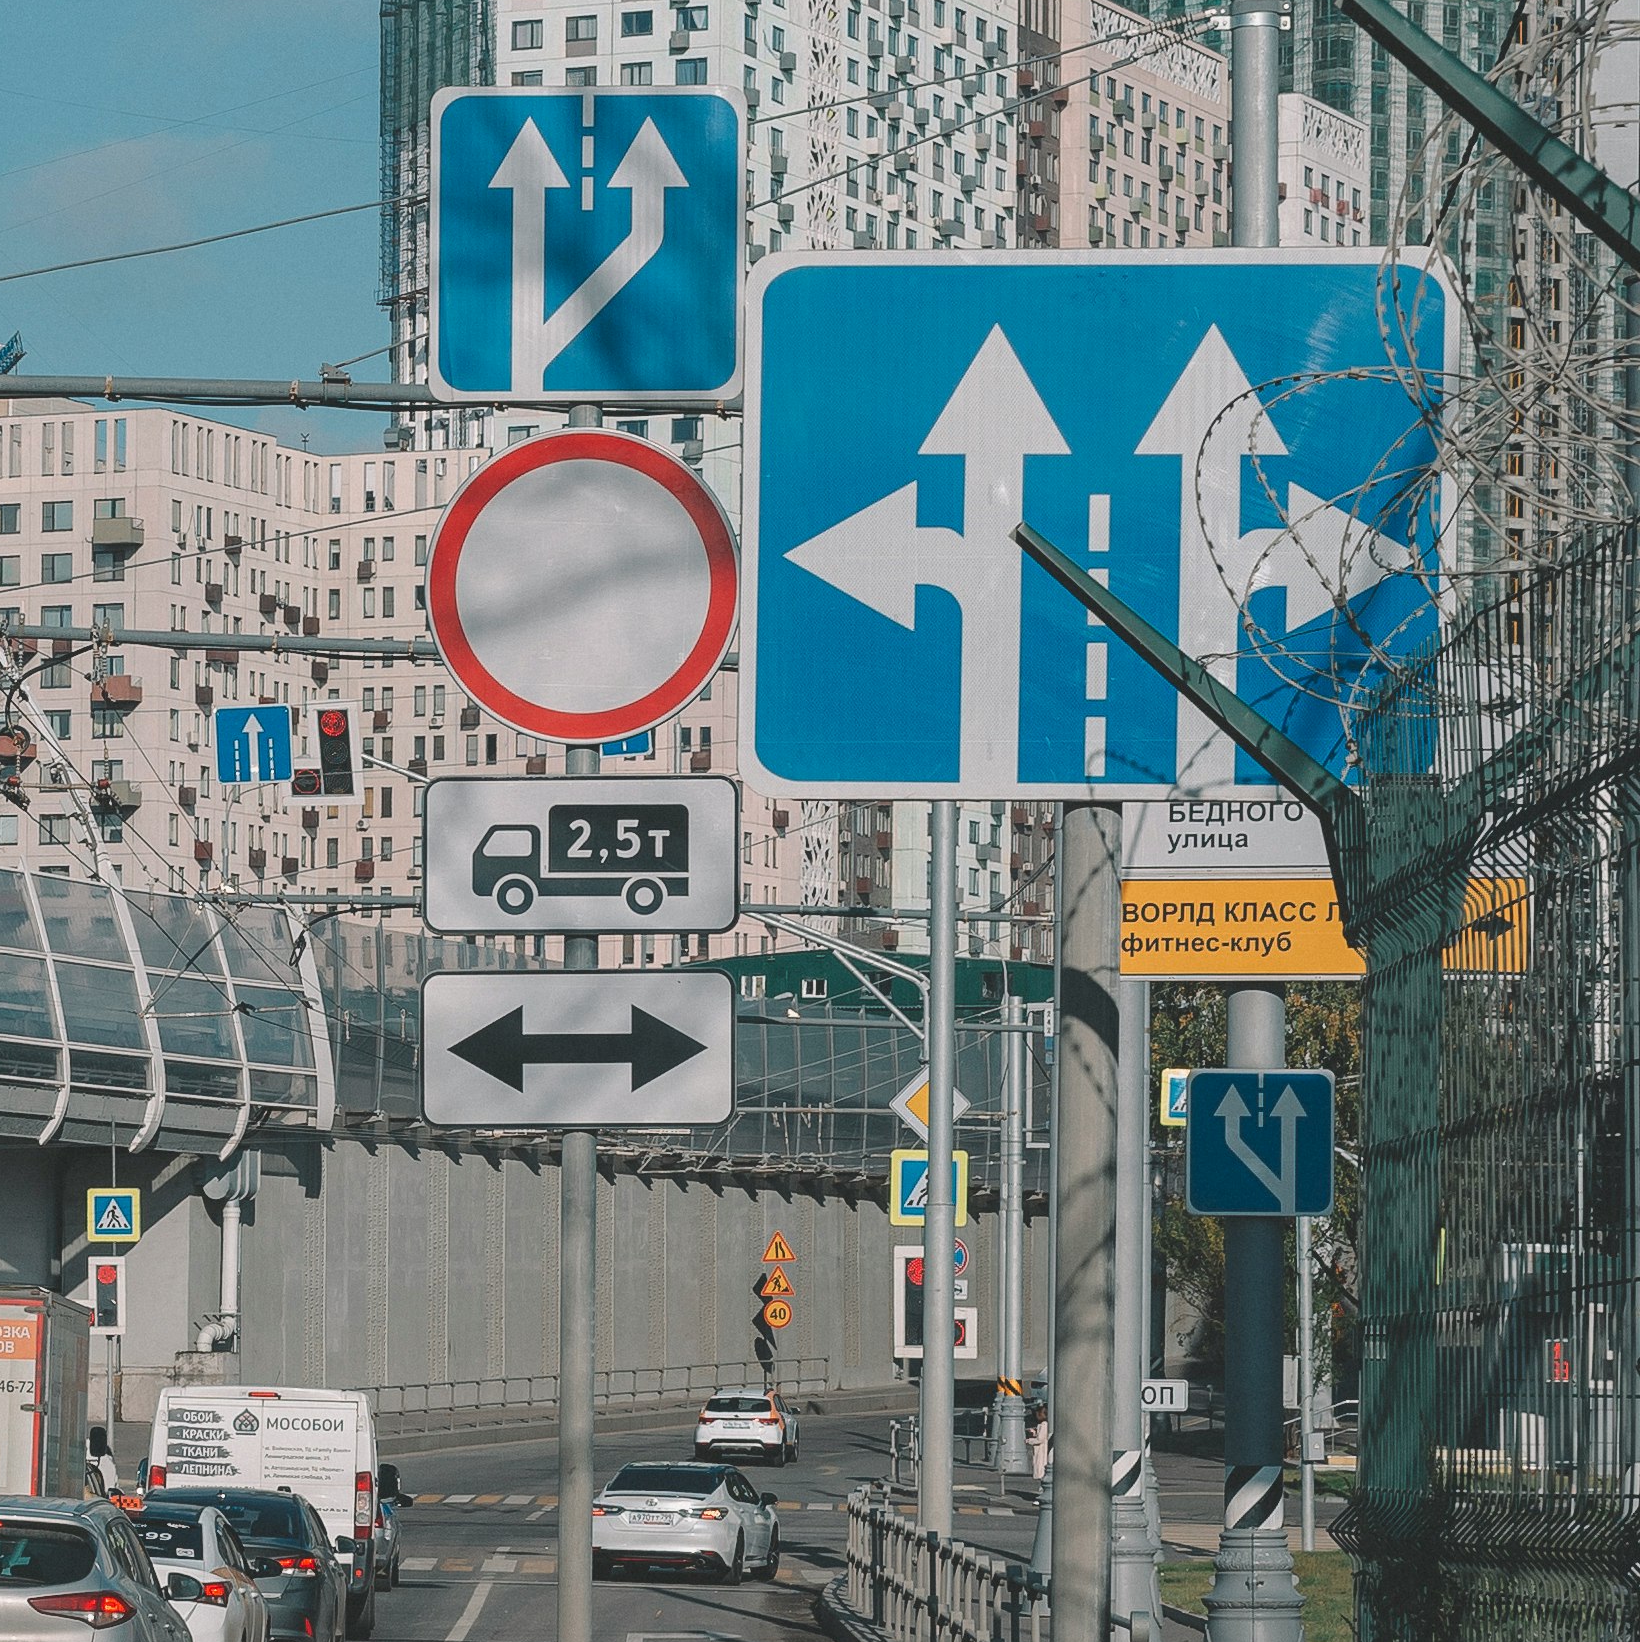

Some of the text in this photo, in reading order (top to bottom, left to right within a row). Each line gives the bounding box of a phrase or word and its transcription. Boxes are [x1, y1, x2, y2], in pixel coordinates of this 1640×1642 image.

[1169, 801, 1304, 826] БЕДНОГО
[1167, 832, 1249, 854] улица
[1122, 902, 1216, 926] ВОРЛД
[1224, 902, 1317, 923] КЛАСС
[1121, 931, 1292, 957] фитнес-клуб
[770, 1308, 787, 1320] 40
[182, 1411, 214, 1423] ОБОИ
[266, 1417, 345, 1432] МОСОБОИ
[182, 1428, 226, 1440] КРАСКИ
[181, 1446, 219, 1458] ТКАНИ
[180, 1463, 233, 1476] ЛЕПНИНА
